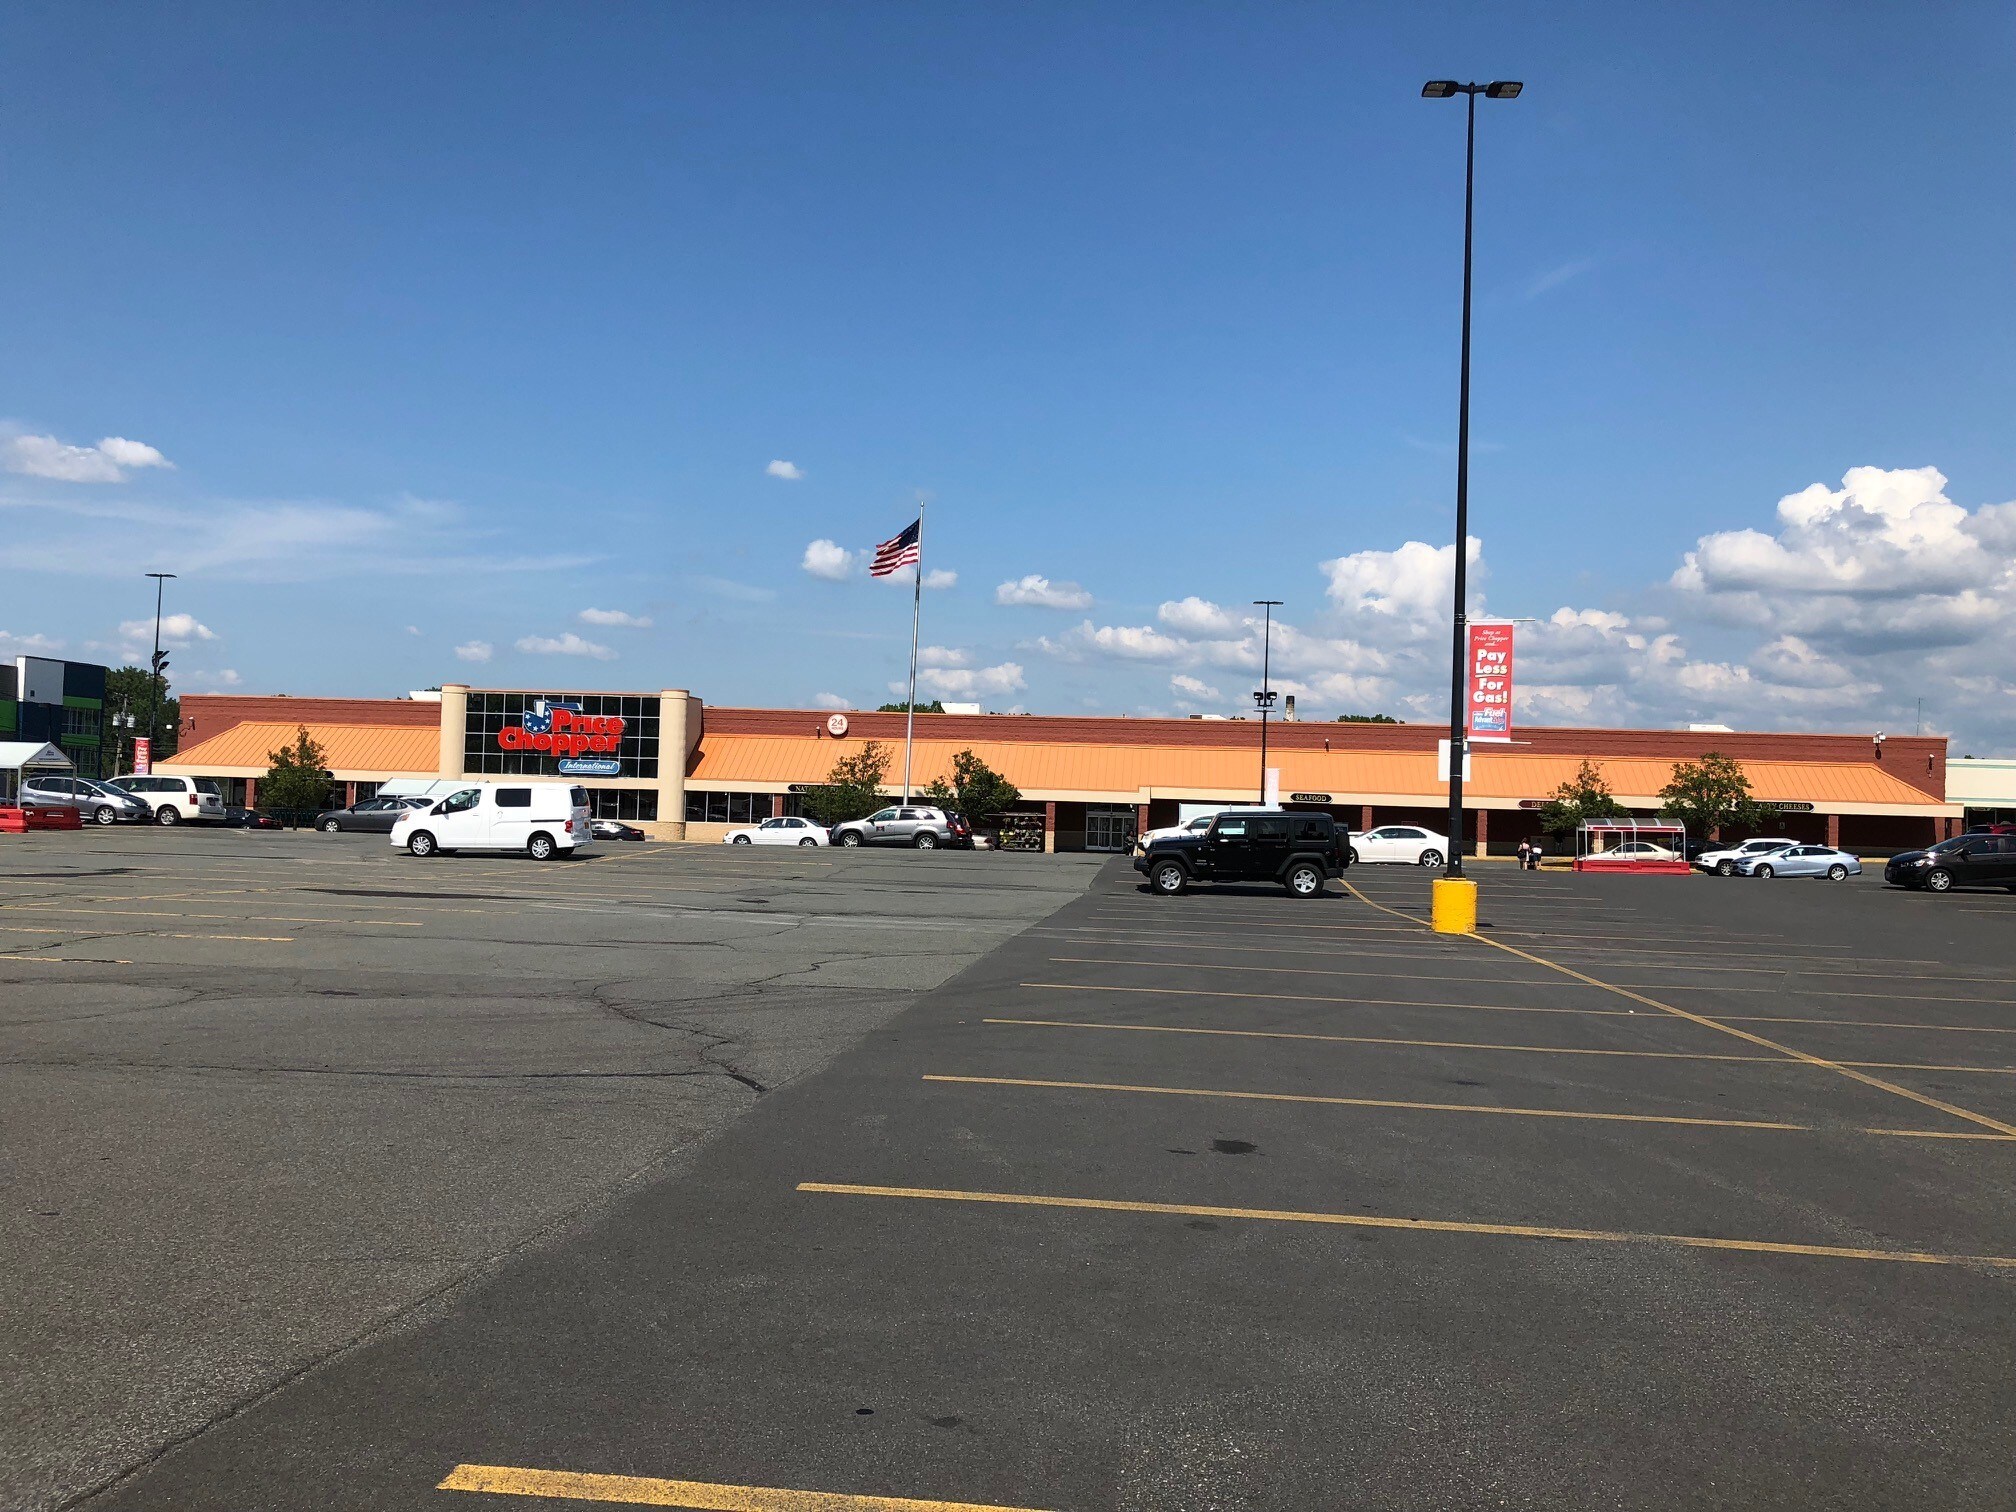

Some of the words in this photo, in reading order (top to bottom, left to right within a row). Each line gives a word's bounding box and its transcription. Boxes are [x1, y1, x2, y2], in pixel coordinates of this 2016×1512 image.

[1477, 649, 1506, 663] Pay
[1475, 662, 1508, 675] Less
[1479, 678, 1504, 690] For
[1473, 691, 1508, 704] Gas!
[1484, 708, 1504, 717] Fuel
[552, 709, 627, 735] Price
[831, 718, 844, 727] 24
[497, 726, 622, 757] Chopper
[563, 761, 615, 771] International
[1295, 794, 1327, 802] SEAFOOD
[1778, 803, 1810, 811] CHEESES
